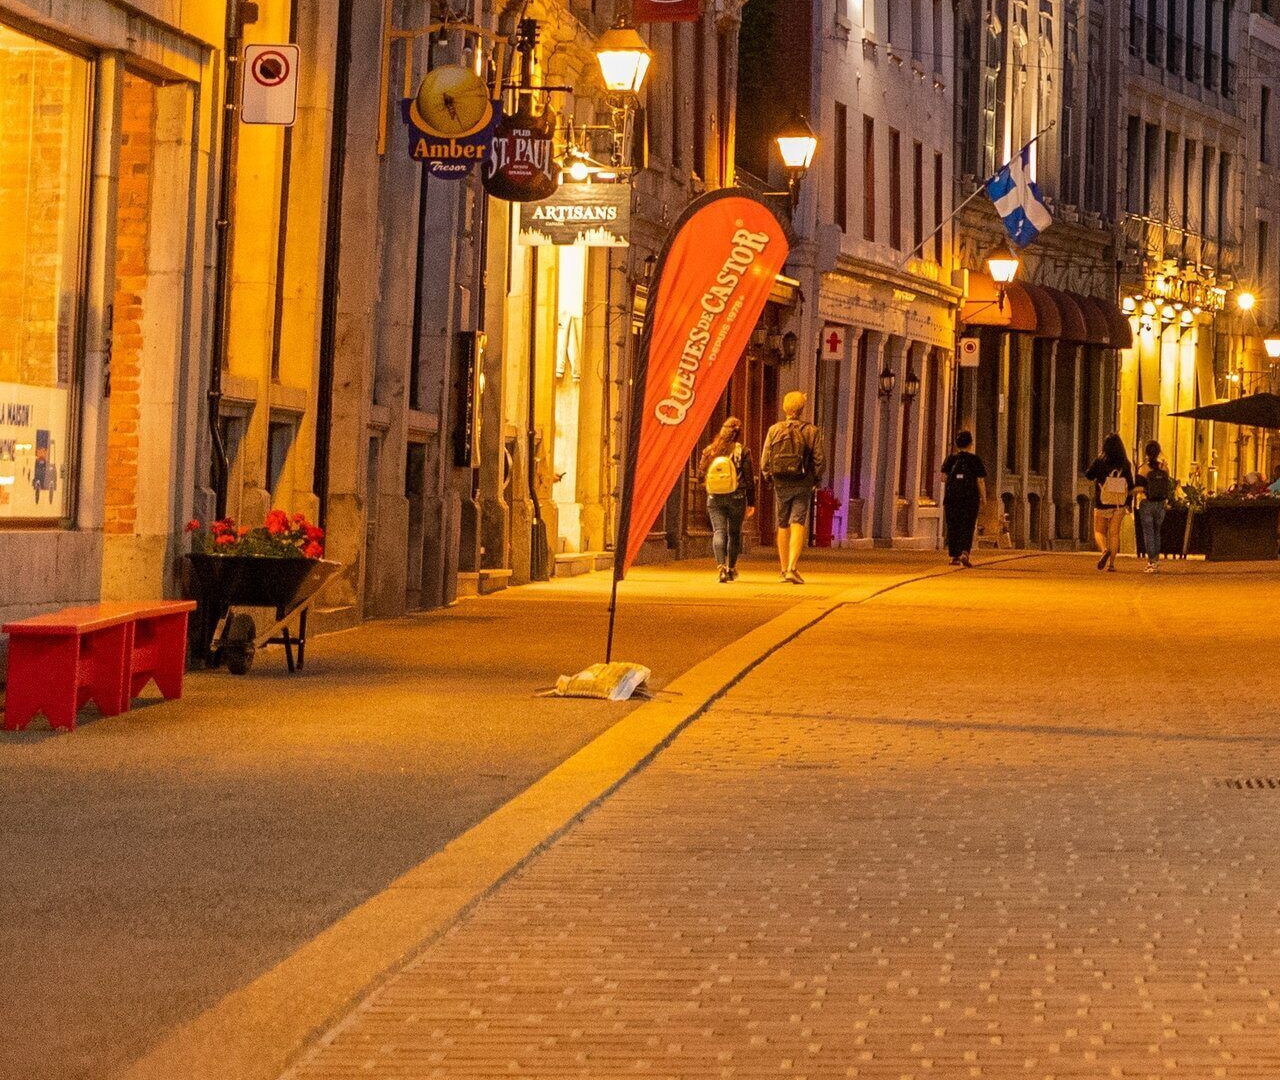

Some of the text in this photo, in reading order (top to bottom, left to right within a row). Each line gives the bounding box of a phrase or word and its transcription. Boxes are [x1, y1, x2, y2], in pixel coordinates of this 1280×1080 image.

[512, 128, 532, 138] PUB
[413, 137, 487, 160] Amber
[430, 160, 467, 172] Tresor
[514, 138, 554, 182] PAUL
[531, 205, 618, 222] ARTISANS
[654, 227, 771, 426] QUEUES DE CASTOR
